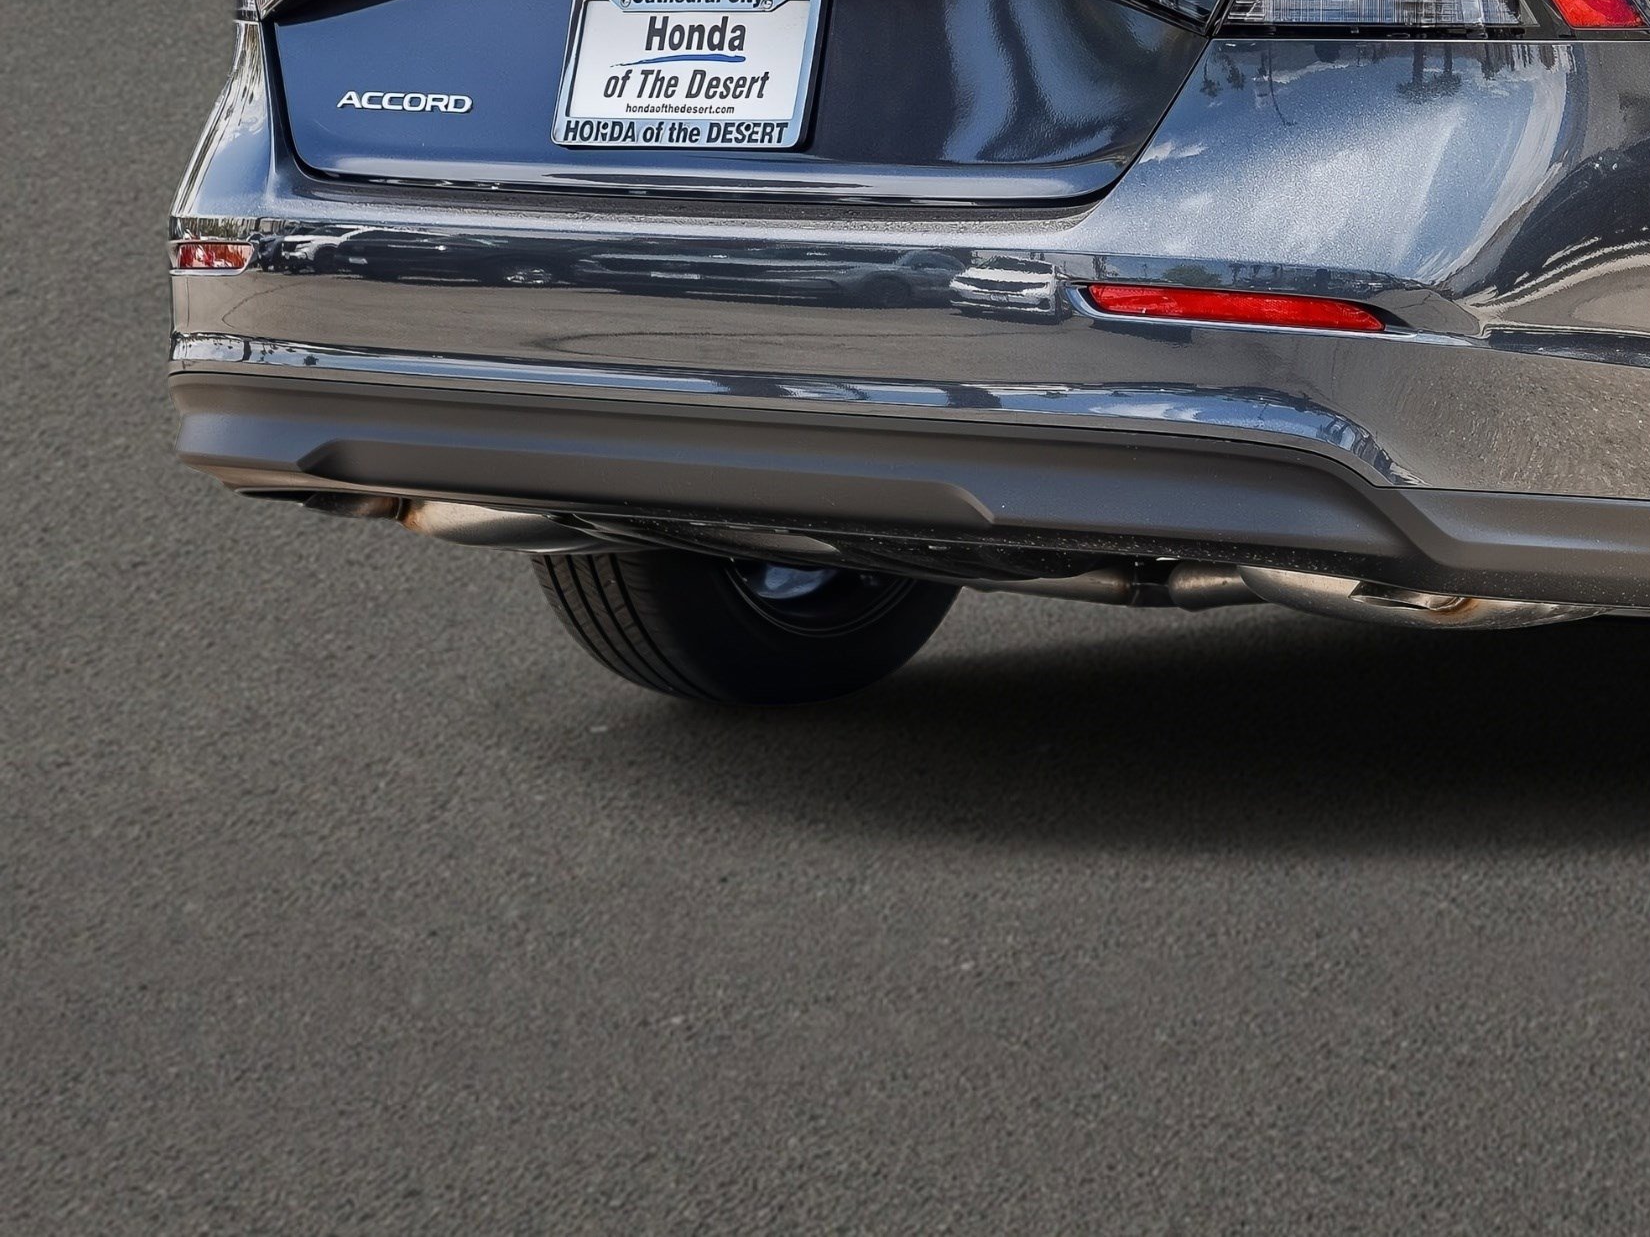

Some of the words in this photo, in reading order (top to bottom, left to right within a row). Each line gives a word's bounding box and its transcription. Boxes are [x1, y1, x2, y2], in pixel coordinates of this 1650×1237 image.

[644, 15, 747, 52] Honda
[603, 69, 633, 99] of
[636, 69, 679, 99] The
[685, 71, 770, 100] Desert
[336, 90, 474, 113] ACCORD
[625, 102, 735, 115] hondaofthedesert.com
[563, 120, 636, 142] HONDA
[642, 121, 663, 143] of
[668, 122, 701, 143] the
[706, 122, 789, 144] DESERT
